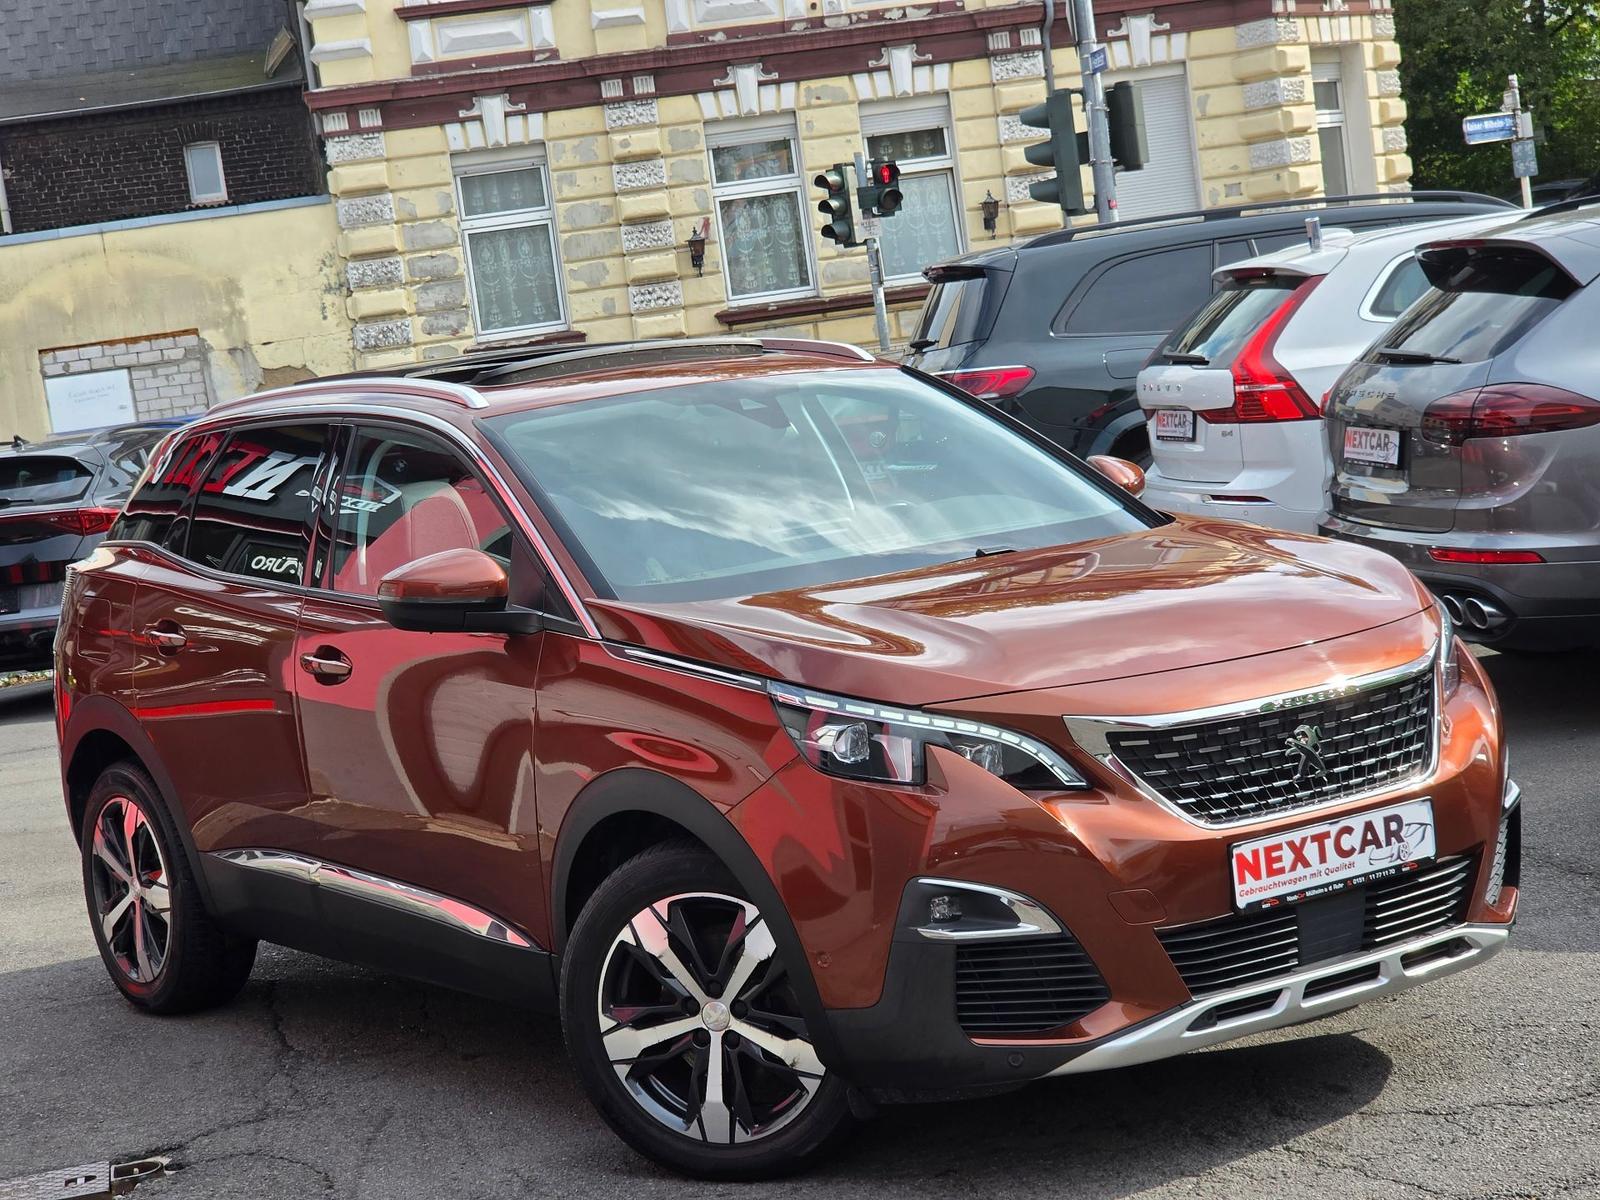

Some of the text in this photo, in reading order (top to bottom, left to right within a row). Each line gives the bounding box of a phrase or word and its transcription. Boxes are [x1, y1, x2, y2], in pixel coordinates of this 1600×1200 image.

[1157, 412, 1187, 428] NEXTCAR
[1345, 430, 1390, 452] NEXTCAR
[1235, 814, 1406, 885] NEXTCAR
[1239, 861, 1356, 898] Gebrauchtwagen mit Qualität
